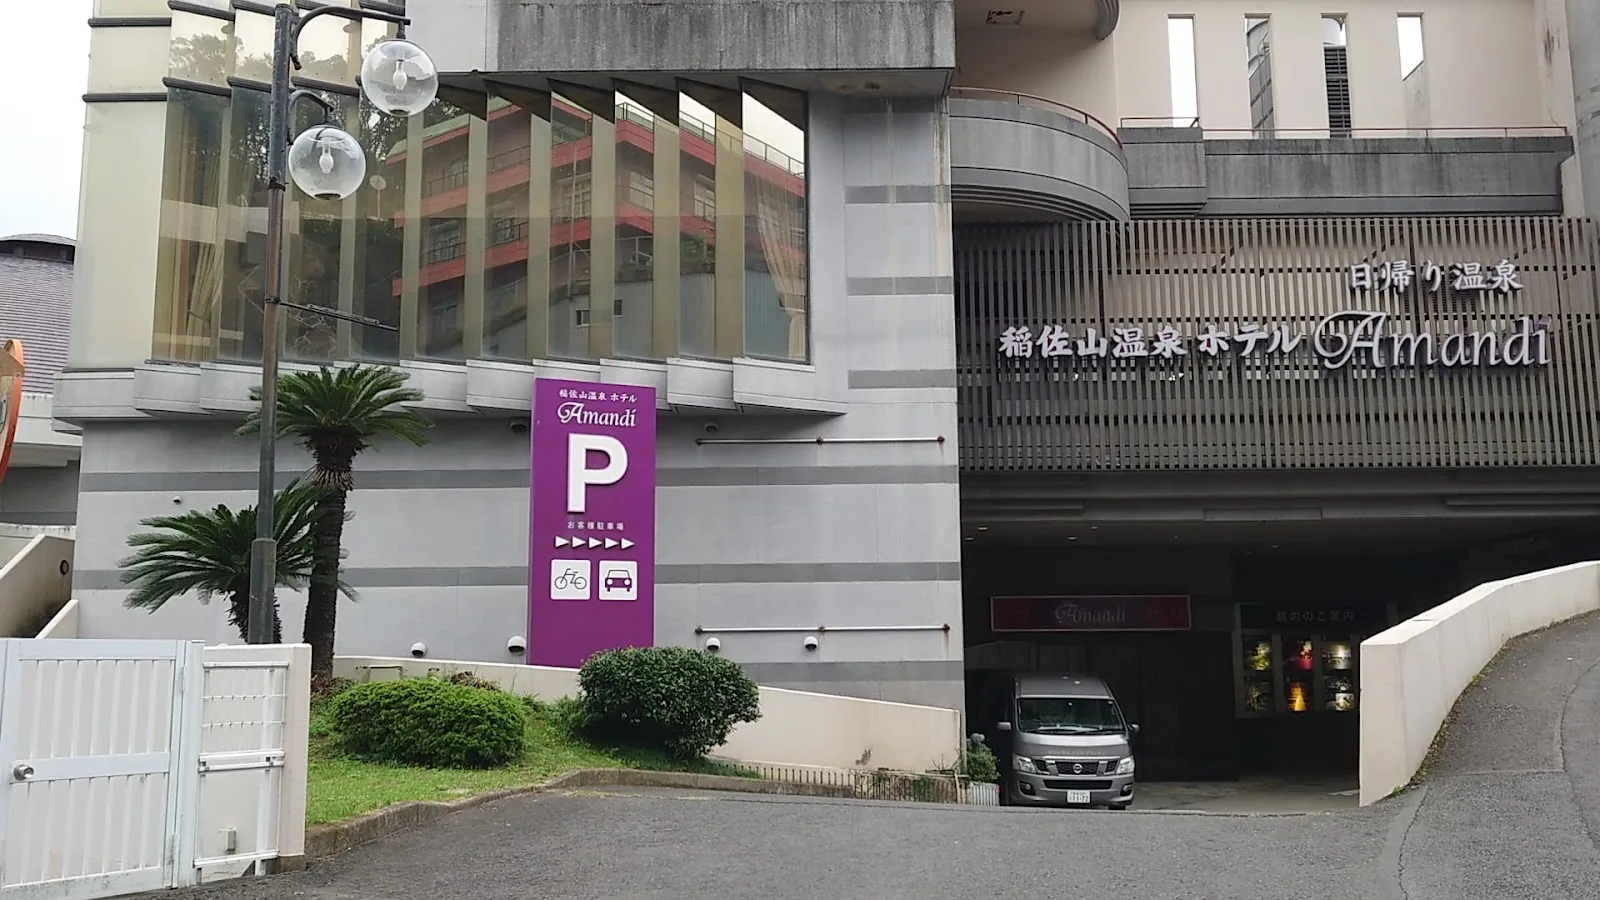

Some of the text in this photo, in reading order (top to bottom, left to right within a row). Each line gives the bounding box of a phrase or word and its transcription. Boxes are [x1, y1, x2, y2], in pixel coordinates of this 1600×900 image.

[1349, 259, 1524, 293] 日帰り温泉
[998, 325, 1188, 358] 稲佐山温泉
[1197, 324, 1301, 356] ホテル
[611, 393, 637, 403] ホテル
[567, 432, 628, 513] P
[567, 520, 624, 531] お客様駐車場
